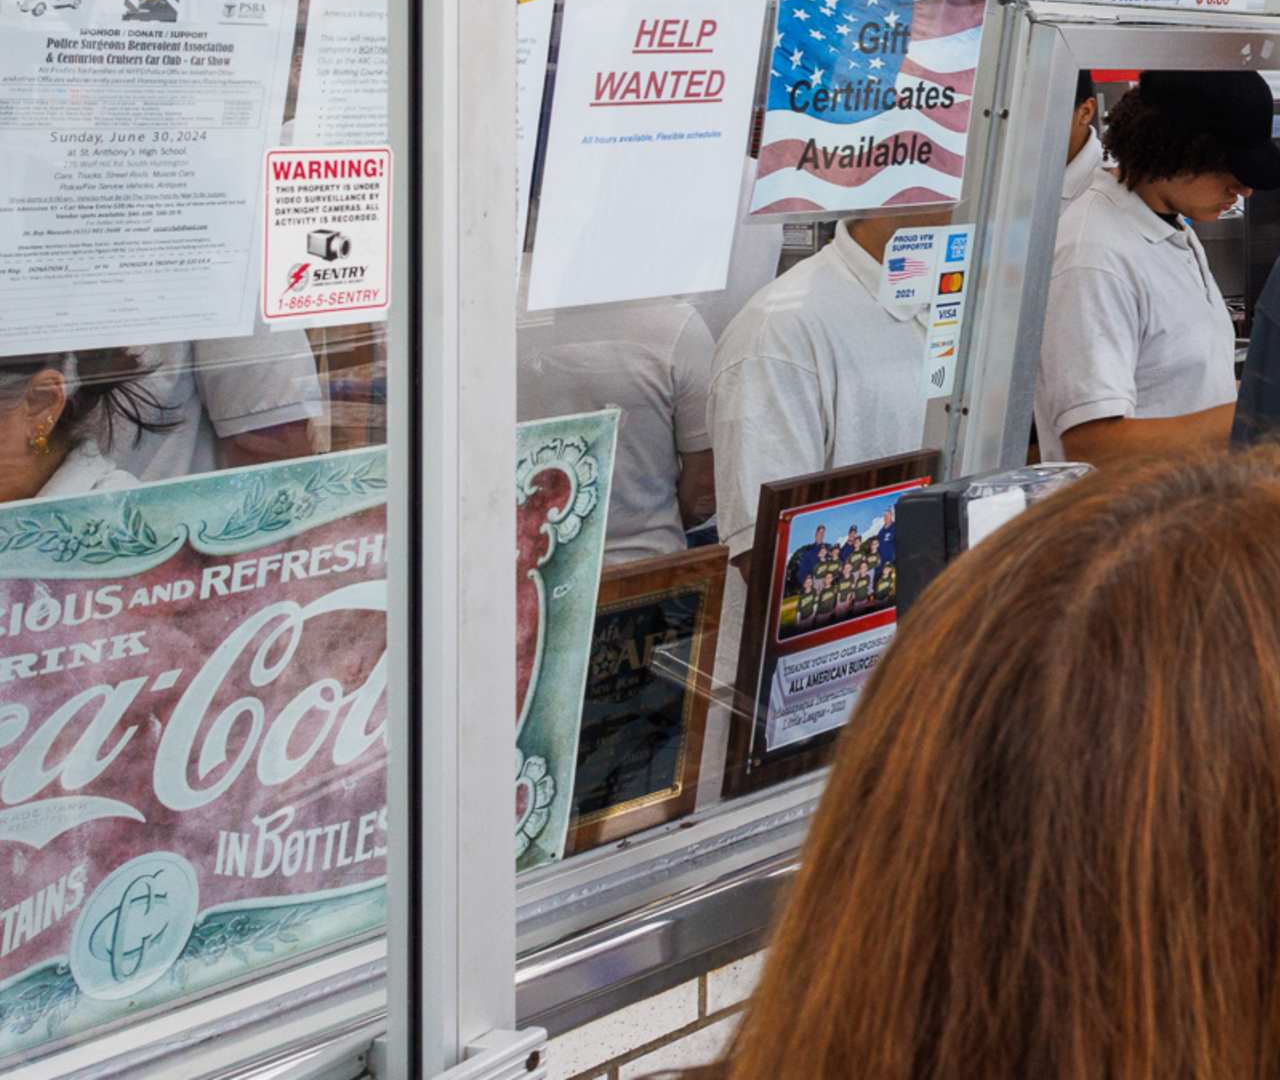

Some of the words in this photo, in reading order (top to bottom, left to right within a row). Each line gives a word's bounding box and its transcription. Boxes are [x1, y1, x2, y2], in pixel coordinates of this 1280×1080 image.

[633, 19, 718, 49] HELP
[857, 21, 910, 57] Gift
[593, 70, 726, 101] WANTED
[789, 79, 956, 113] Certificates
[109, 131, 146, 143] June
[797, 136, 933, 170] Available
[272, 159, 384, 181] WARNING!
[275, 196, 302, 204] VIDEO
[304, 194, 366, 203] SURVEILLANCE
[297, 184, 340, 192] PROPERTY
[313, 266, 368, 282] SENTRY
[278, 289, 380, 310] 1-866-5-SENTRY
[938, 308, 957, 319] VISA
[128, 578, 195, 610] AND
[789, 679, 804, 694] ALL
[806, 663, 849, 688] AMERICAN
[214, 829, 246, 878] IN
